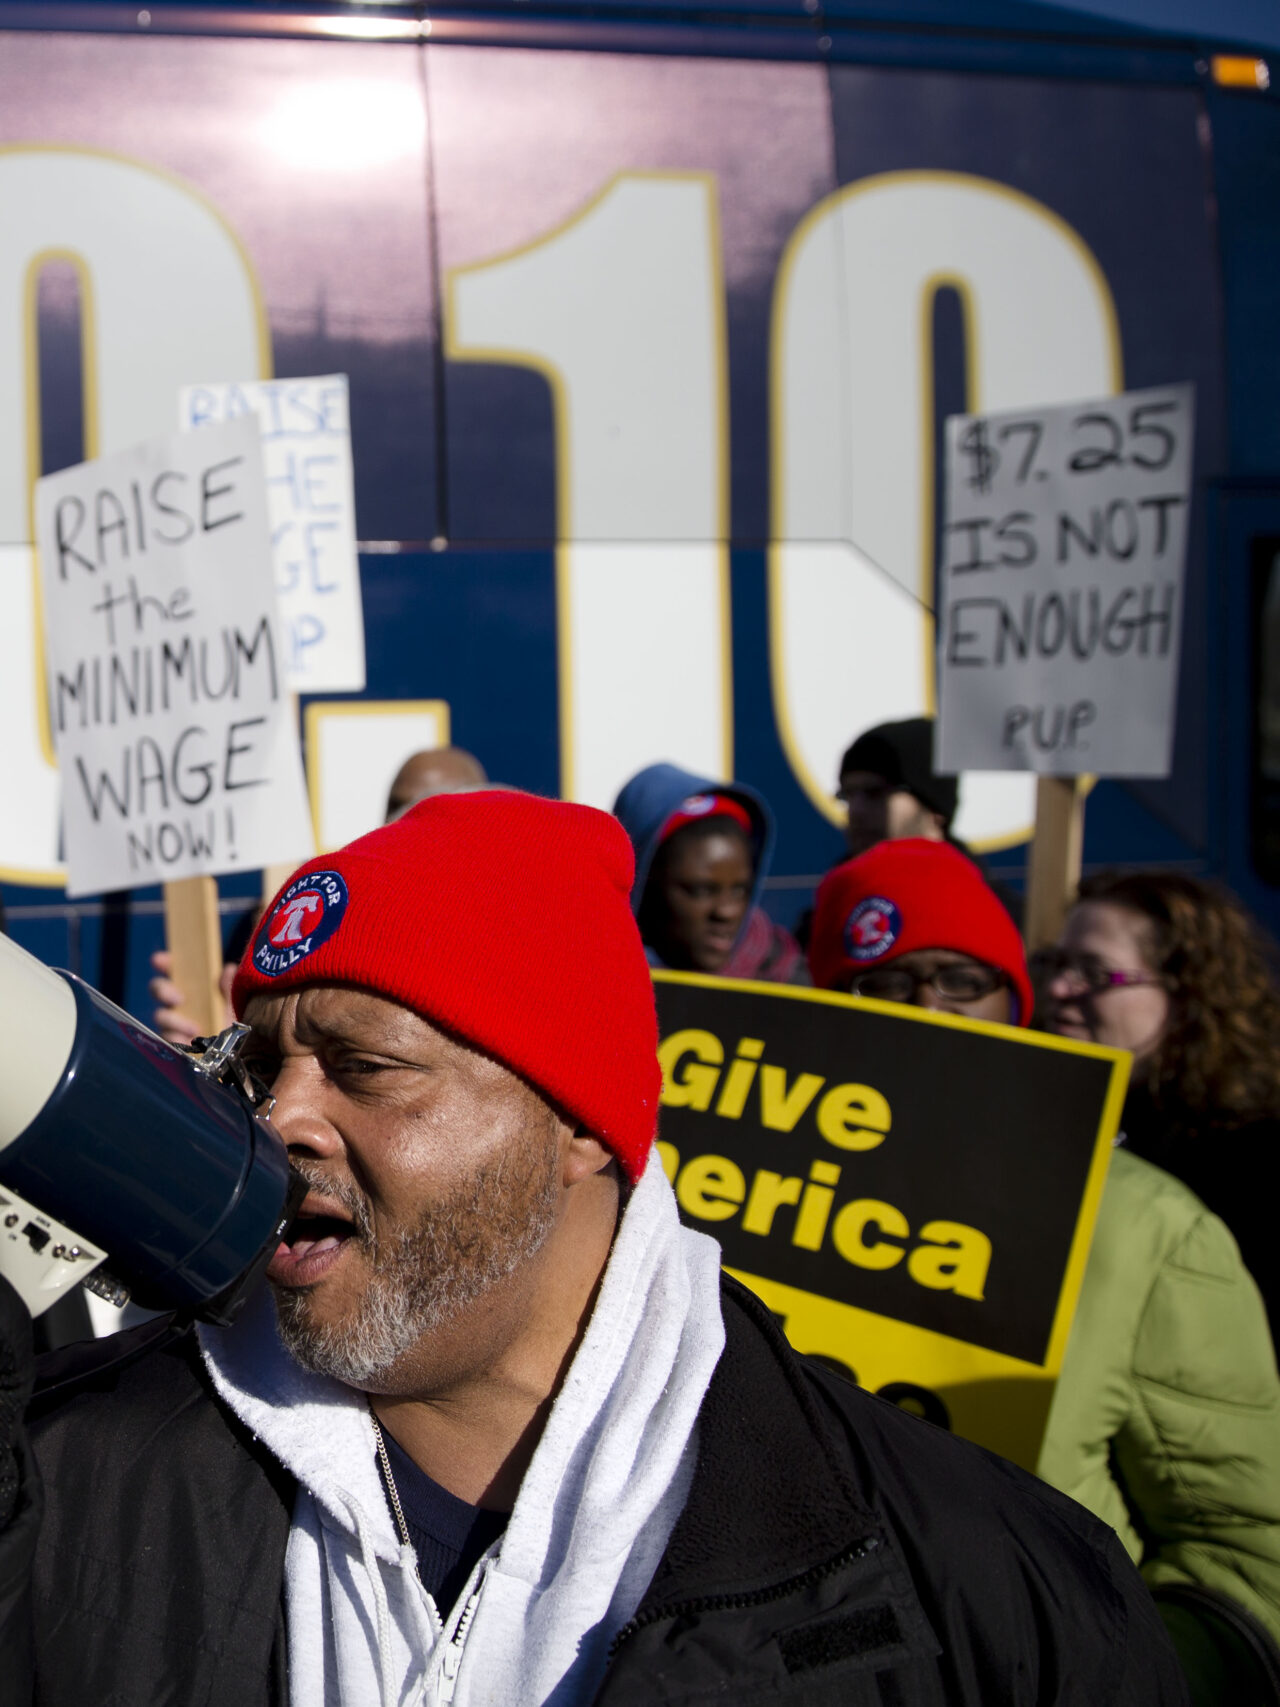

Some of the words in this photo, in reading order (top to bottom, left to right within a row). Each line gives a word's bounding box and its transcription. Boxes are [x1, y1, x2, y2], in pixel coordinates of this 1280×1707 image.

[189, 384, 348, 443] RAISE
[957, 400, 1180, 496] $7.25
[53, 456, 245, 583] RAISE
[266, 451, 340, 514] HE
[270, 521, 340, 595] GE
[946, 510, 1039, 577] IS
[1055, 496, 1184, 566] NOT
[91, 576, 197, 646] the
[946, 583, 1177, 669] ENOUGH
[57, 614, 279, 734] MINIMUM
[75, 715, 272, 823] WAGE
[126, 807, 238, 872] NOW!
[320, 875, 341, 907] FOR
[256, 937, 313, 971] PHILLY
[655, 1028, 893, 1152] Give
[654, 1140, 992, 1301] erica
